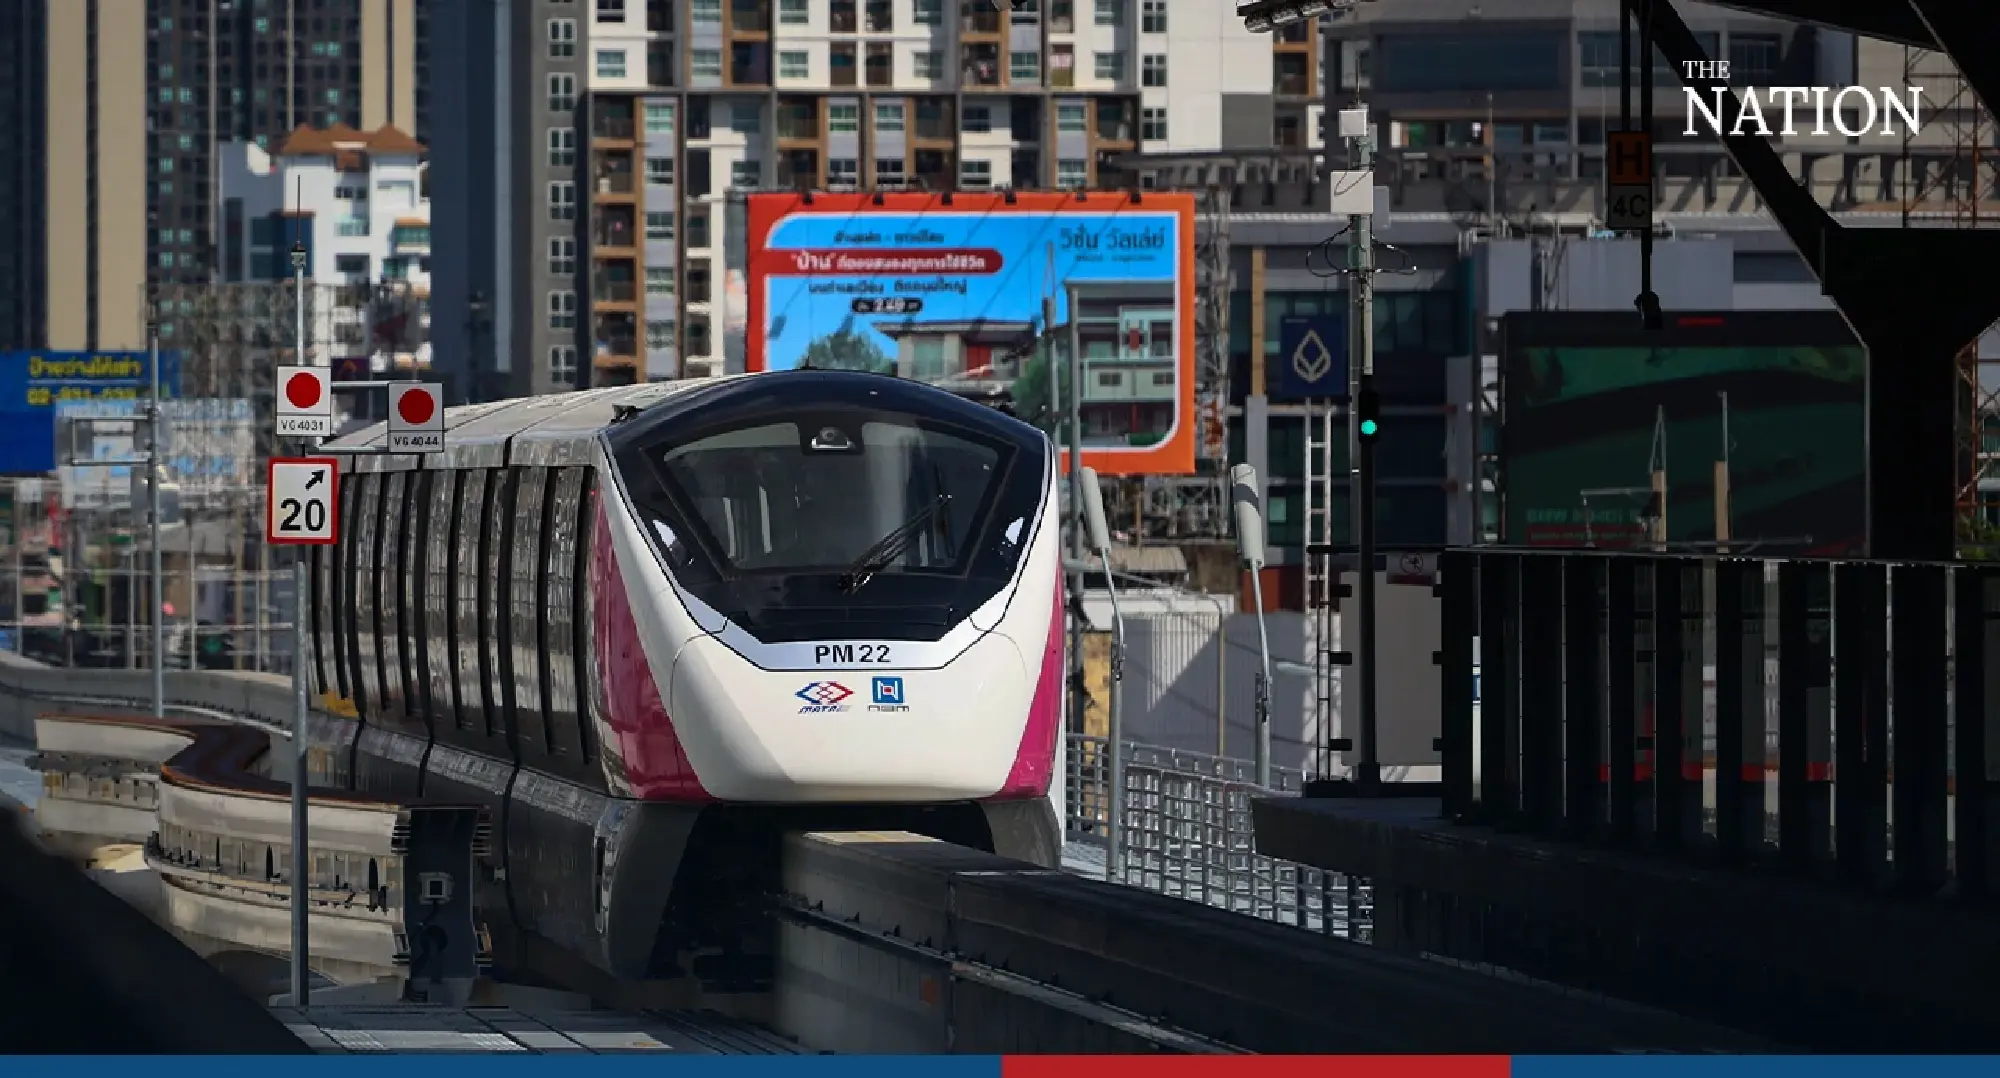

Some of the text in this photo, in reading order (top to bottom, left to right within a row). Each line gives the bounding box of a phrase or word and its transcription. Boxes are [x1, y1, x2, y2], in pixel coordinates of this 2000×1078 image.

[1616, 141, 1643, 176] H
[1613, 194, 1647, 218] 4C
[279, 497, 326, 532] 20
